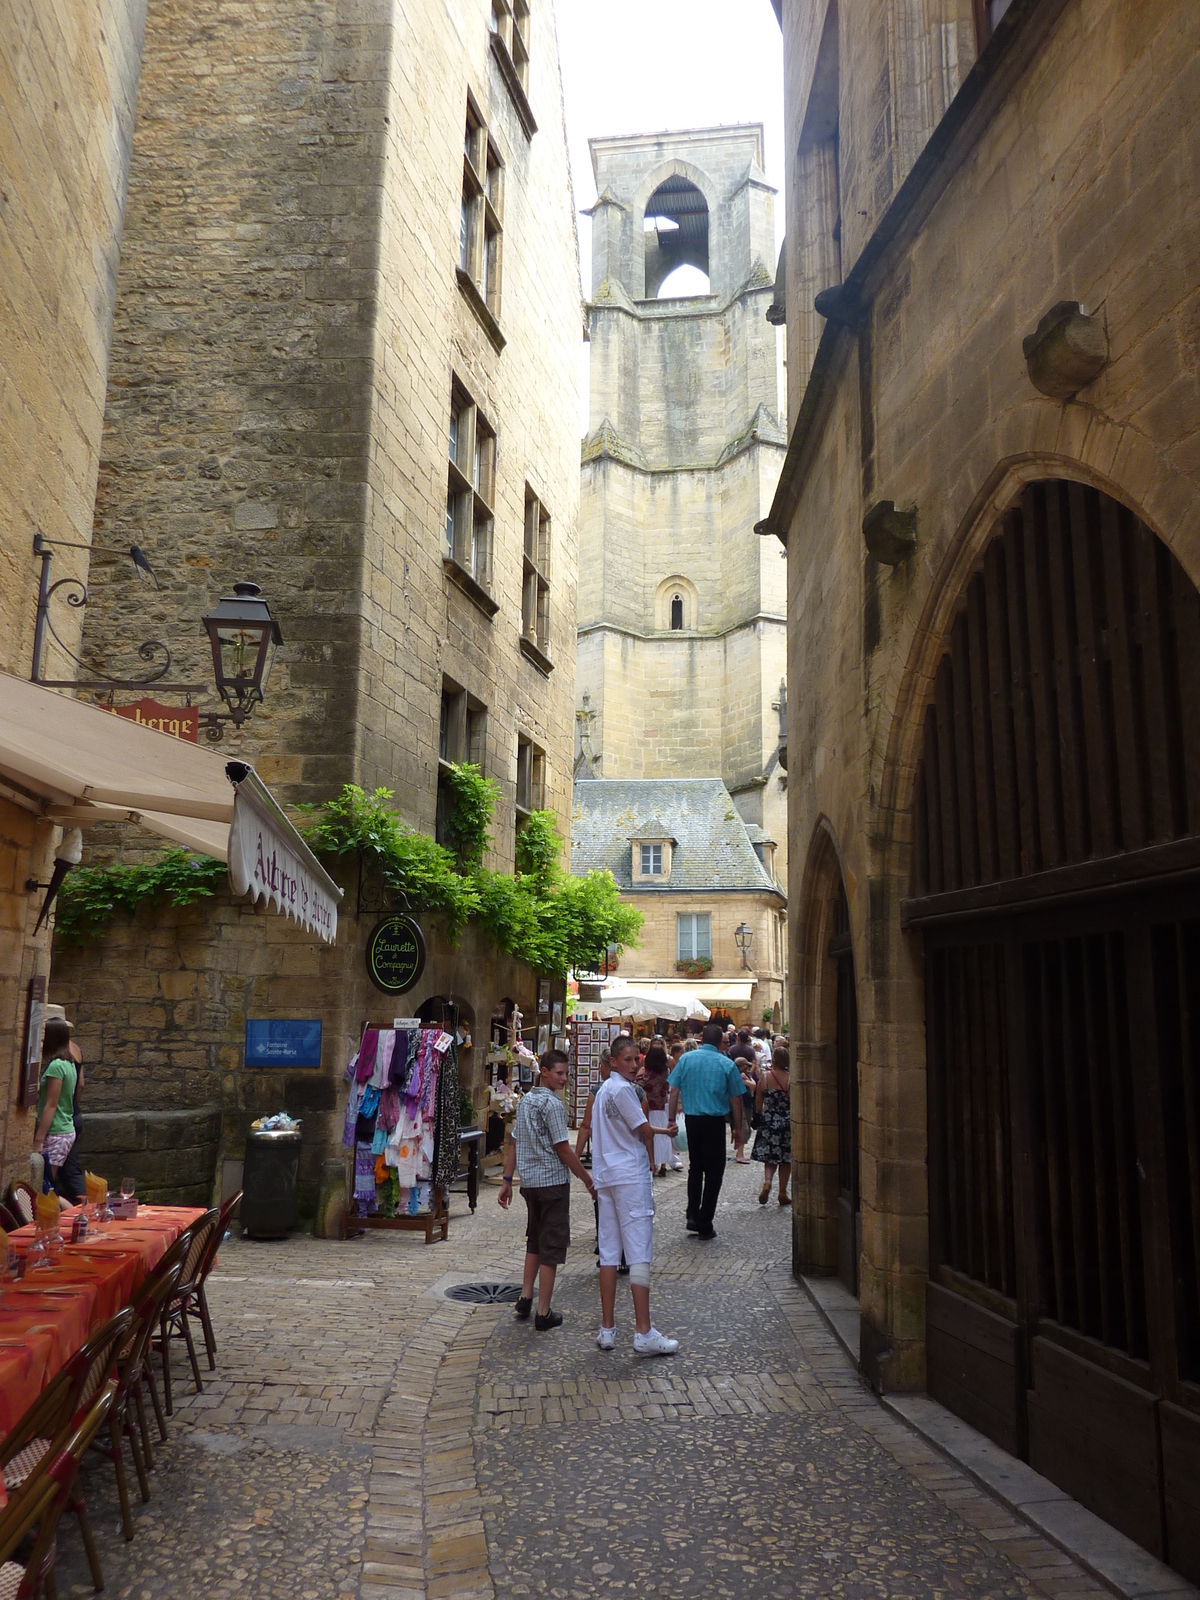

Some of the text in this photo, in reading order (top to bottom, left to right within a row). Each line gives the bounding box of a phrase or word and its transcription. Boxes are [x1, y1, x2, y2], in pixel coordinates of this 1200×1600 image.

[111, 707, 194, 738] berge
[375, 938, 416, 954] Laurette
[375, 955, 414, 973] Compagnie
